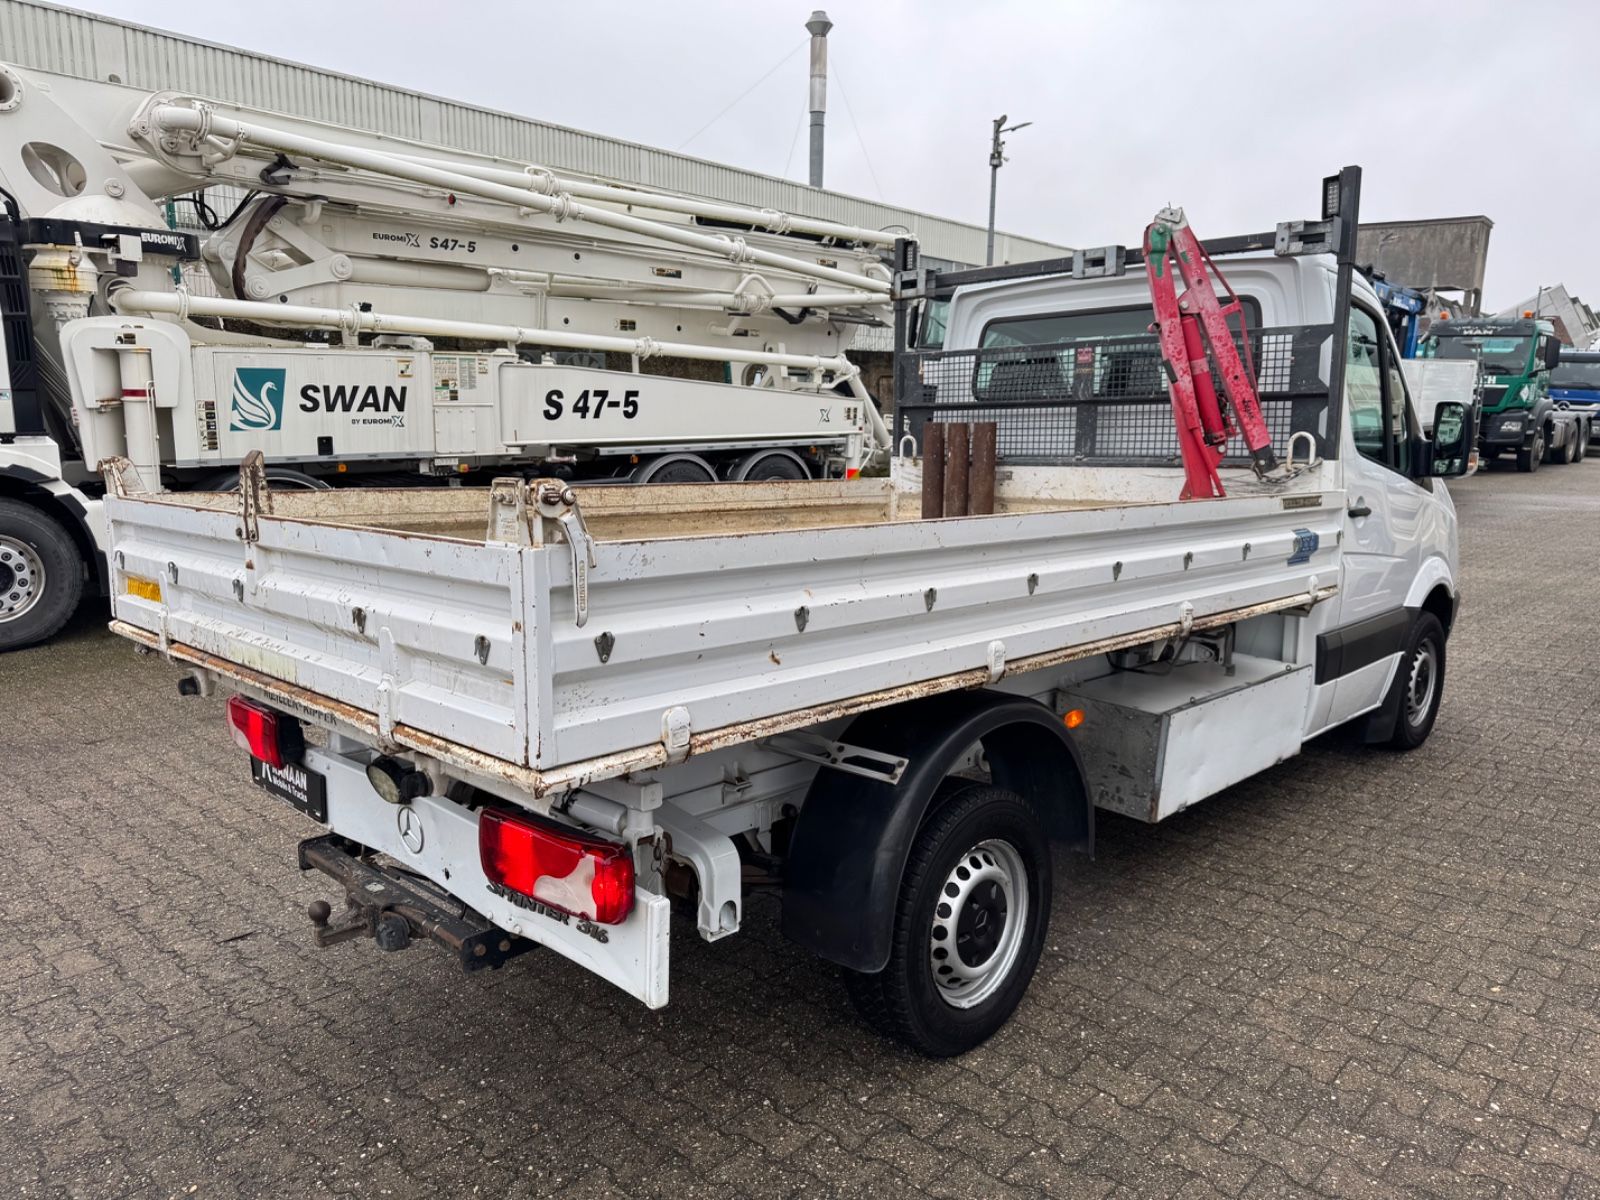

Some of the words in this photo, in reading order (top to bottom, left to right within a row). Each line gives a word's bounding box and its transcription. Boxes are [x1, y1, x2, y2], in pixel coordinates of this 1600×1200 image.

[141, 232, 187, 252] EUROMIX
[372, 232, 420, 248] EUROMIX
[430, 236, 477, 253] S47-5
[299, 384, 408, 413] SWAN
[543, 389, 565, 421] S
[572, 389, 640, 420] 47-5
[362, 415, 405, 428] EUROMIX
[485, 882, 571, 926] SPRINTER
[575, 919, 610, 944] 316
